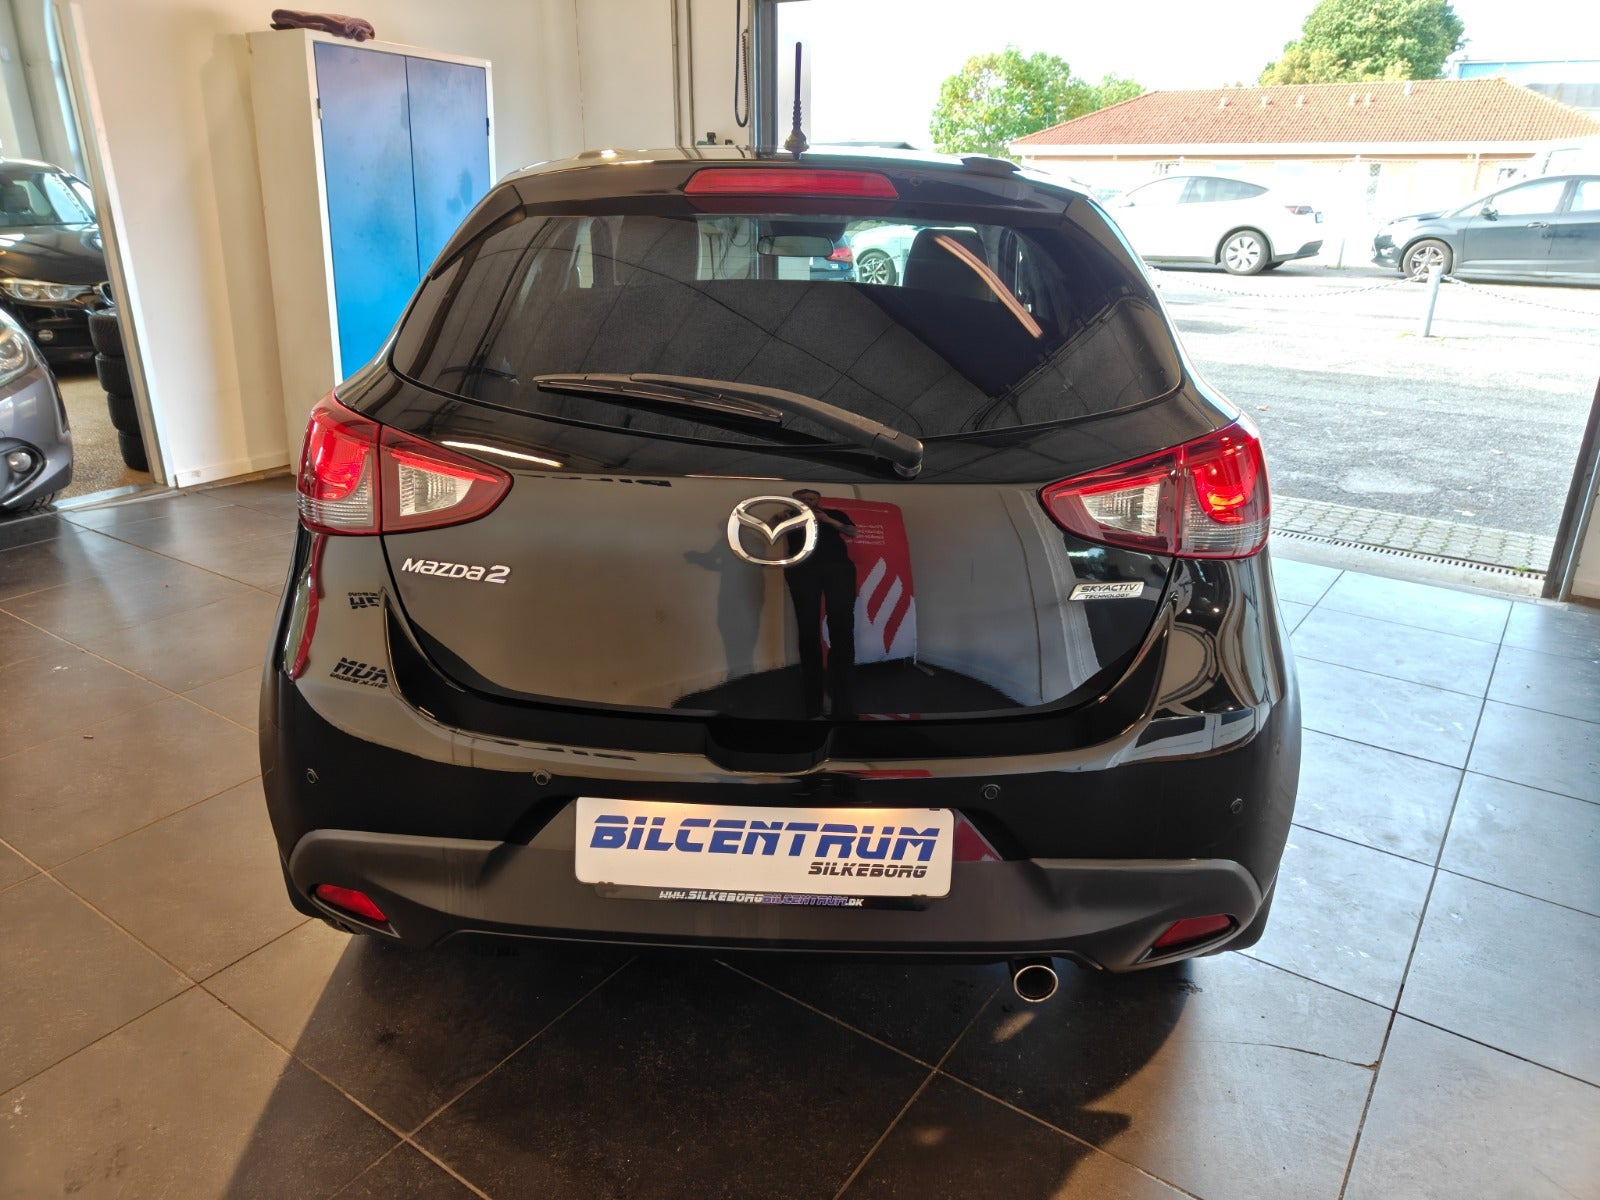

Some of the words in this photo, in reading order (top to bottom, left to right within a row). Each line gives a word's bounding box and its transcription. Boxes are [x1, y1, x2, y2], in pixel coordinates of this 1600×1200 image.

[1080, 583, 1139, 593] SKYACTIV
[589, 814, 941, 862] BILCENTRUM
[807, 861, 928, 879] SILKEBORG
